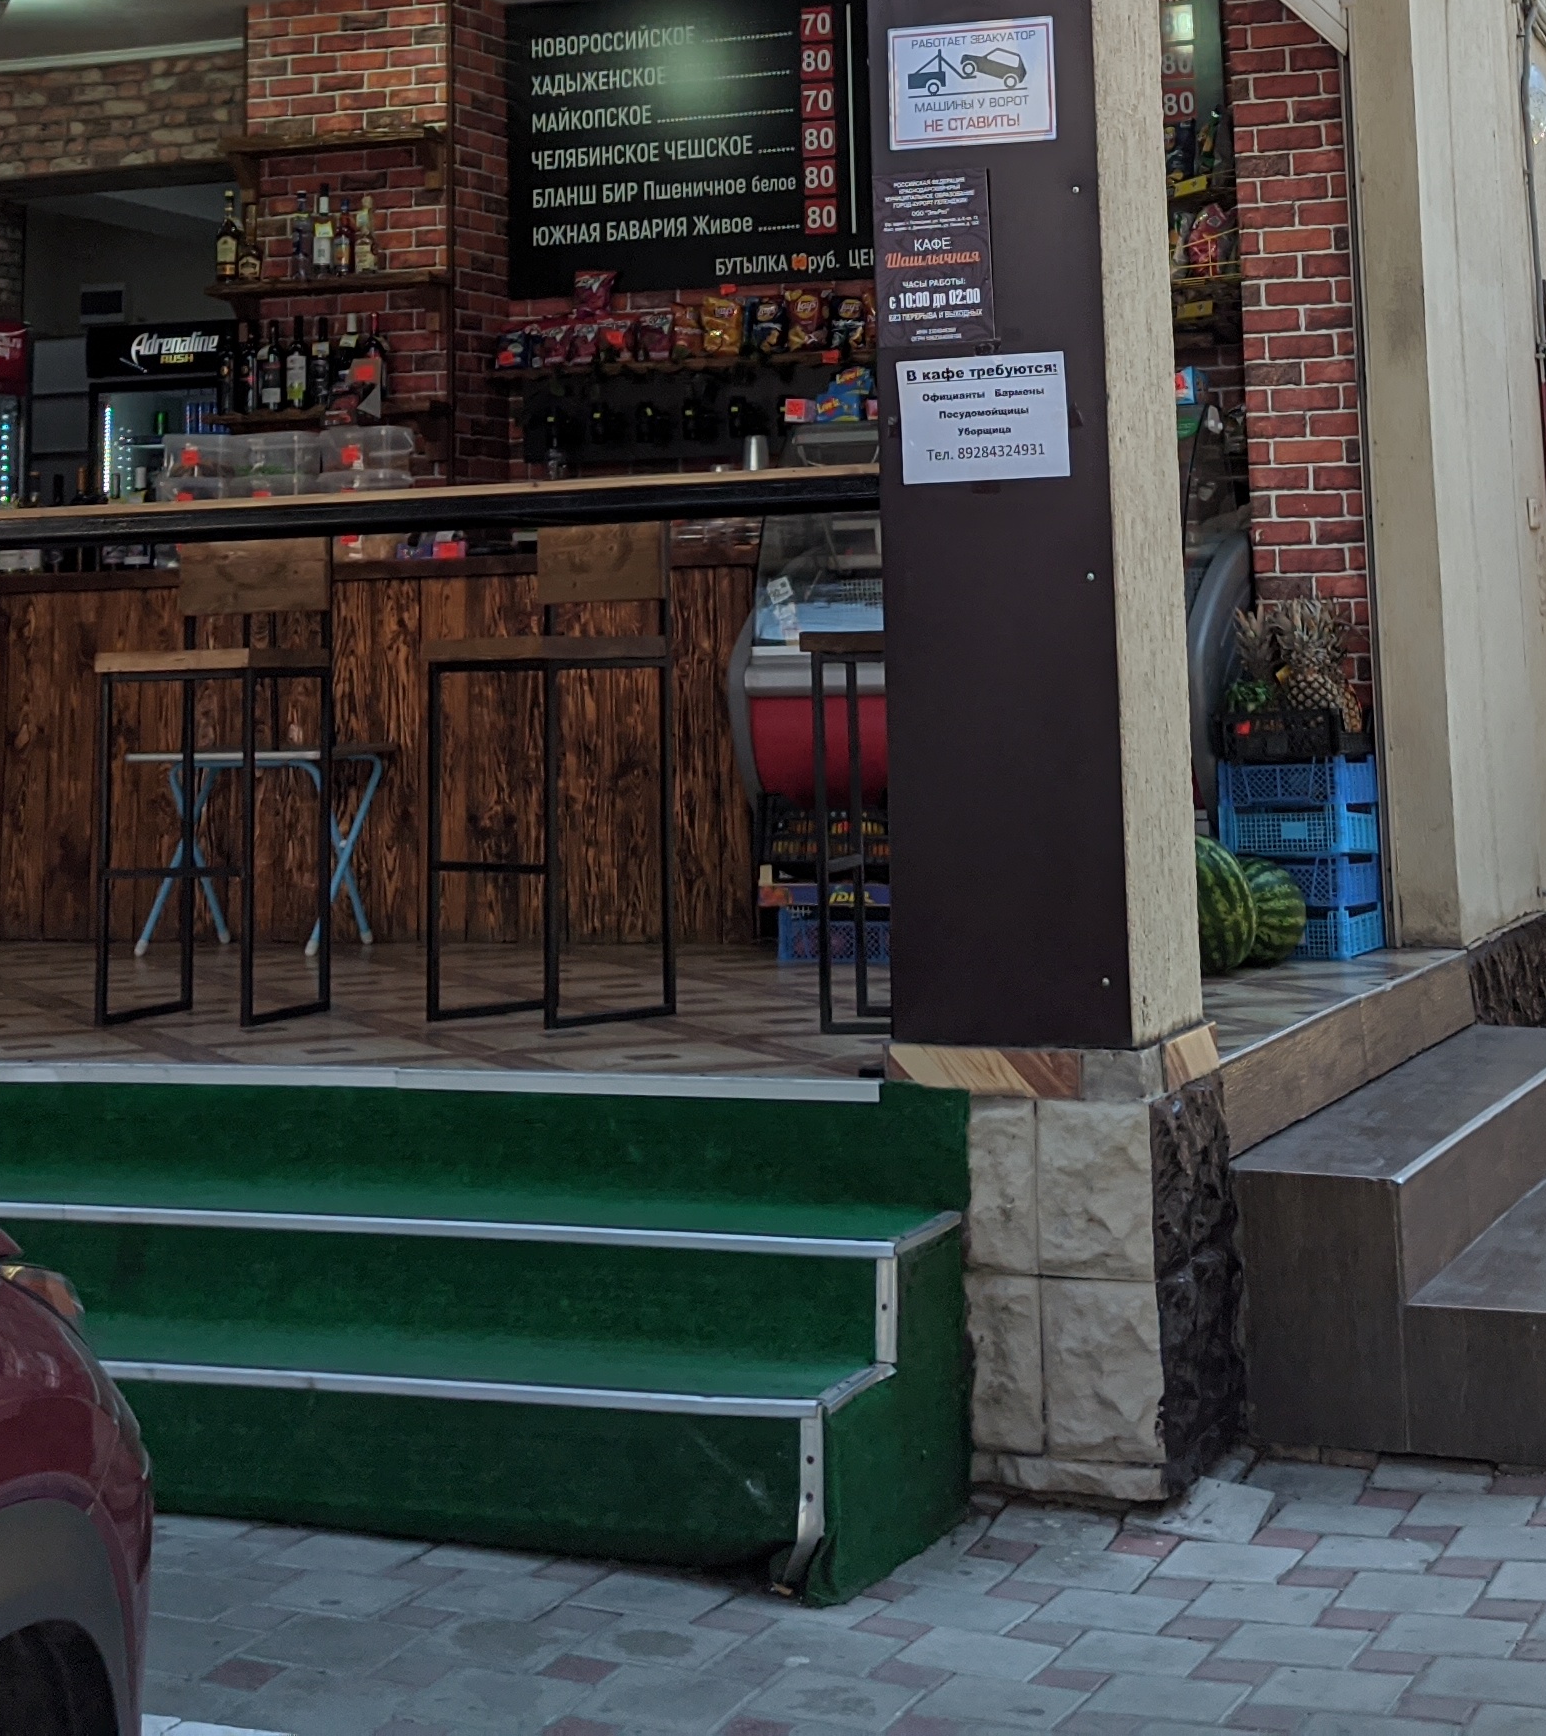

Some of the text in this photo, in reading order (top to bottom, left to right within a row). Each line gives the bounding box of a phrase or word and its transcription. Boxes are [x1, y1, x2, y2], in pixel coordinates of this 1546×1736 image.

[531, 12, 831, 59] НОВОРОССИЙСКОЕ 70
[911, 29, 1036, 50] РАБОТАЕТ ЭВАКУАТОР
[531, 49, 831, 97] ХАДЫЖЕНСКОЕ 80
[531, 89, 832, 134] МАЙКОПСКОЕ 70
[914, 94, 1029, 114] МАШИНЫ У ВОРОТ
[1163, 91, 1195, 116] 80
[924, 113, 1020, 133] НЕ СТАВИТЬ!
[531, 127, 834, 171] ЧЕЛЯБИНСКОЕ ЧЕШСКОЕ 80
[532, 165, 834, 209] БЛАНШ БИР Пшеничное белое 80
[532, 206, 837, 248] ЮЖНАЯ БАВАРИЯ Живое 80
[914, 236, 952, 251] КАФЕ
[715, 253, 788, 276] БУТЫЛКА
[884, 249, 981, 269] Шашлычная
[902, 277, 966, 288] ЧАСЫ РАБОТЫ:
[899, 291, 930, 309] 10:00
[932, 293, 946, 309] до
[948, 287, 981, 305] 02:00
[130, 330, 220, 366] Adrenaline
[159, 353, 194, 365] RUSH
[906, 369, 917, 382] В
[922, 367, 965, 382] кафе
[922, 387, 1045, 403] Официанты Бармены
[938, 406, 1030, 420] Посудомойщицы
[957, 426, 1012, 437] Уборщица
[926, 442, 1045, 463] Тел. 89284324931
